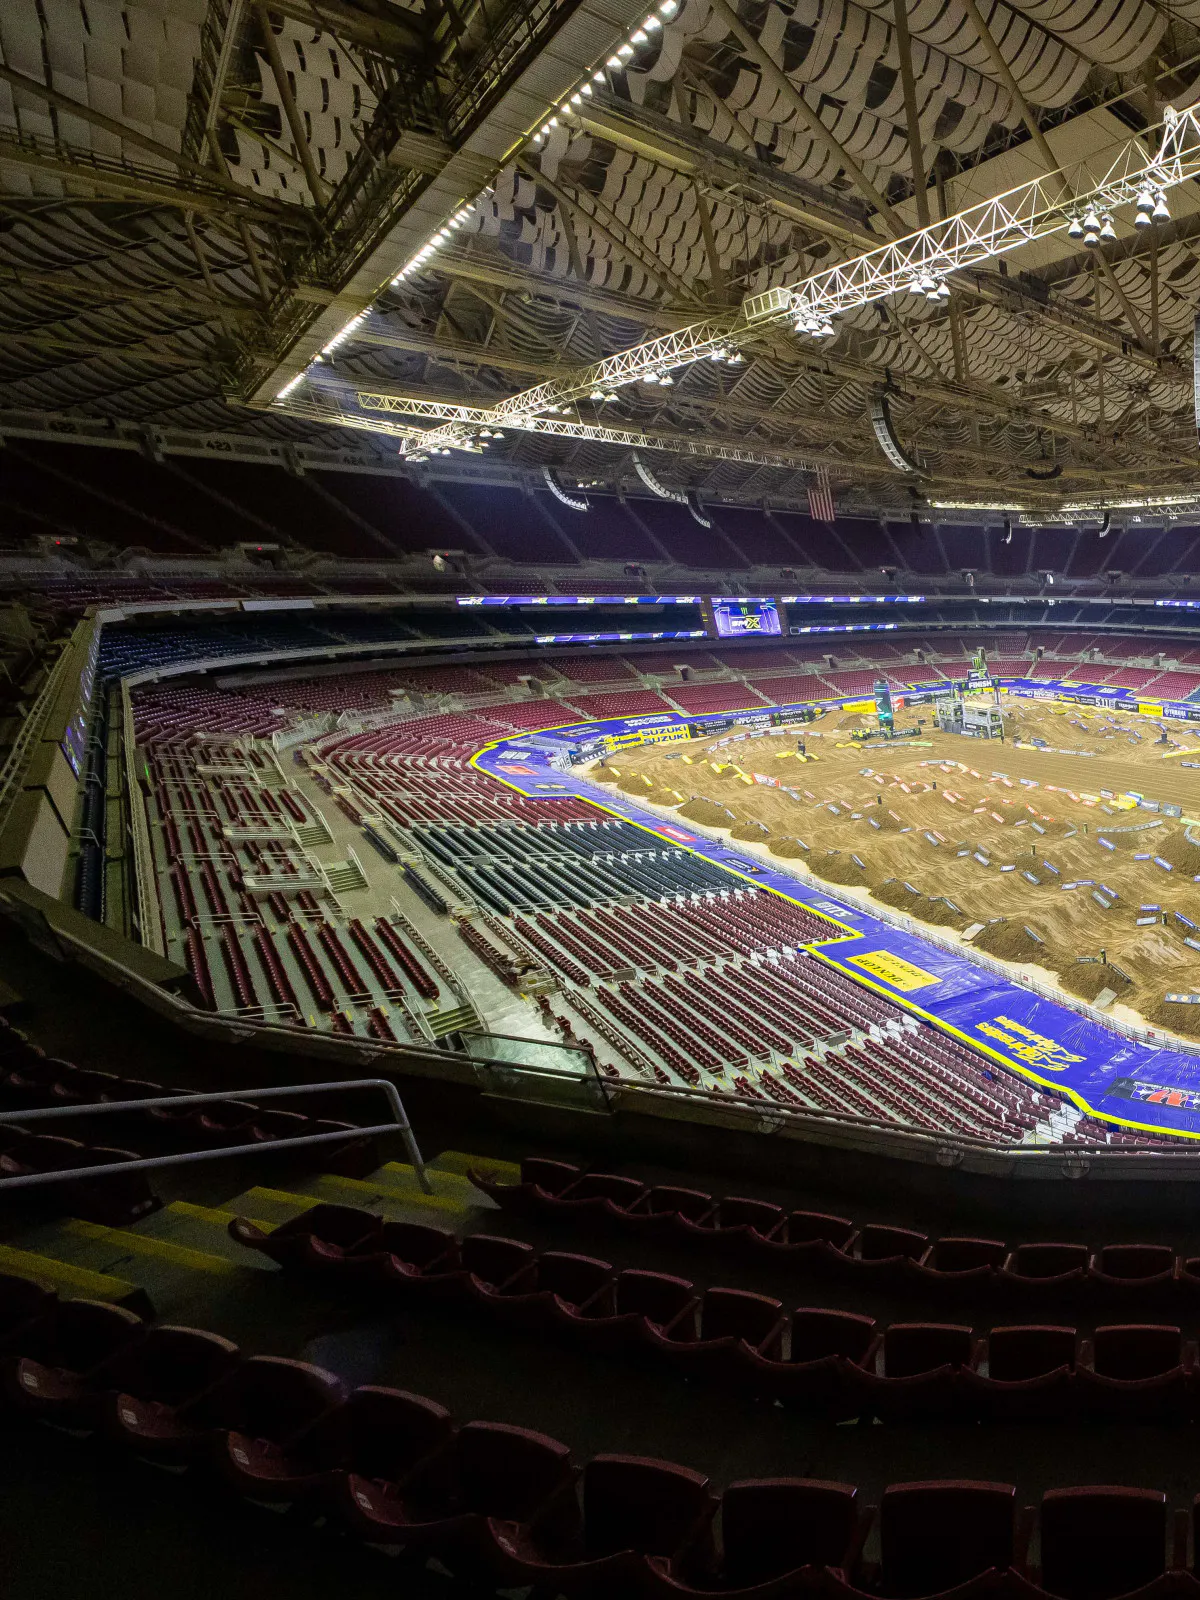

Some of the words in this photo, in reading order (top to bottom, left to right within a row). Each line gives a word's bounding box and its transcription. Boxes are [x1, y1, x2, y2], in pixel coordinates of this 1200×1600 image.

[206, 440, 232, 451] 423
[968, 681, 993, 689] FINISH
[1169, 707, 1187, 717] YAMAHA
[641, 726, 687, 736] SUZUKI
[857, 958, 903, 983] DUNLOP
